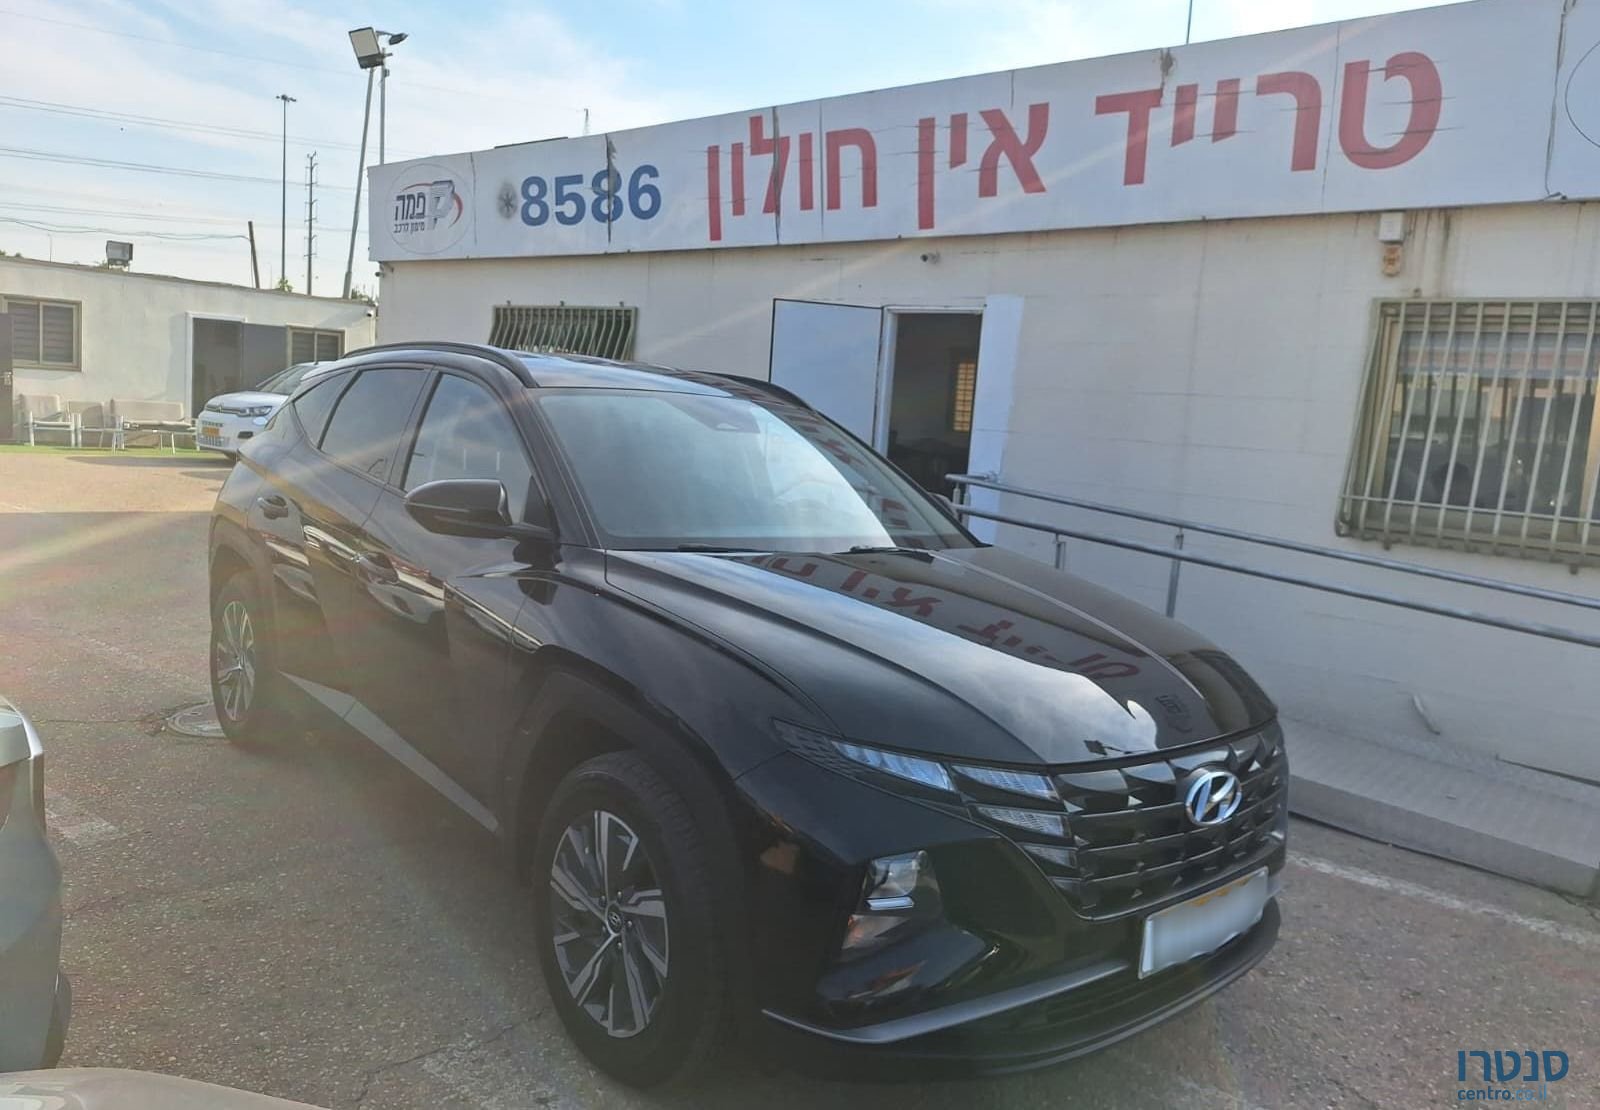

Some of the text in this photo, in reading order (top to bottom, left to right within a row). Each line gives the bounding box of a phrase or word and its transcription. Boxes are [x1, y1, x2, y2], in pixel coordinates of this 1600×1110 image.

[706, 114, 878, 242] חולון
[917, 101, 1050, 231] אין
[1095, 51, 1443, 186] טרייד
[395, 191, 426, 221] פמה
